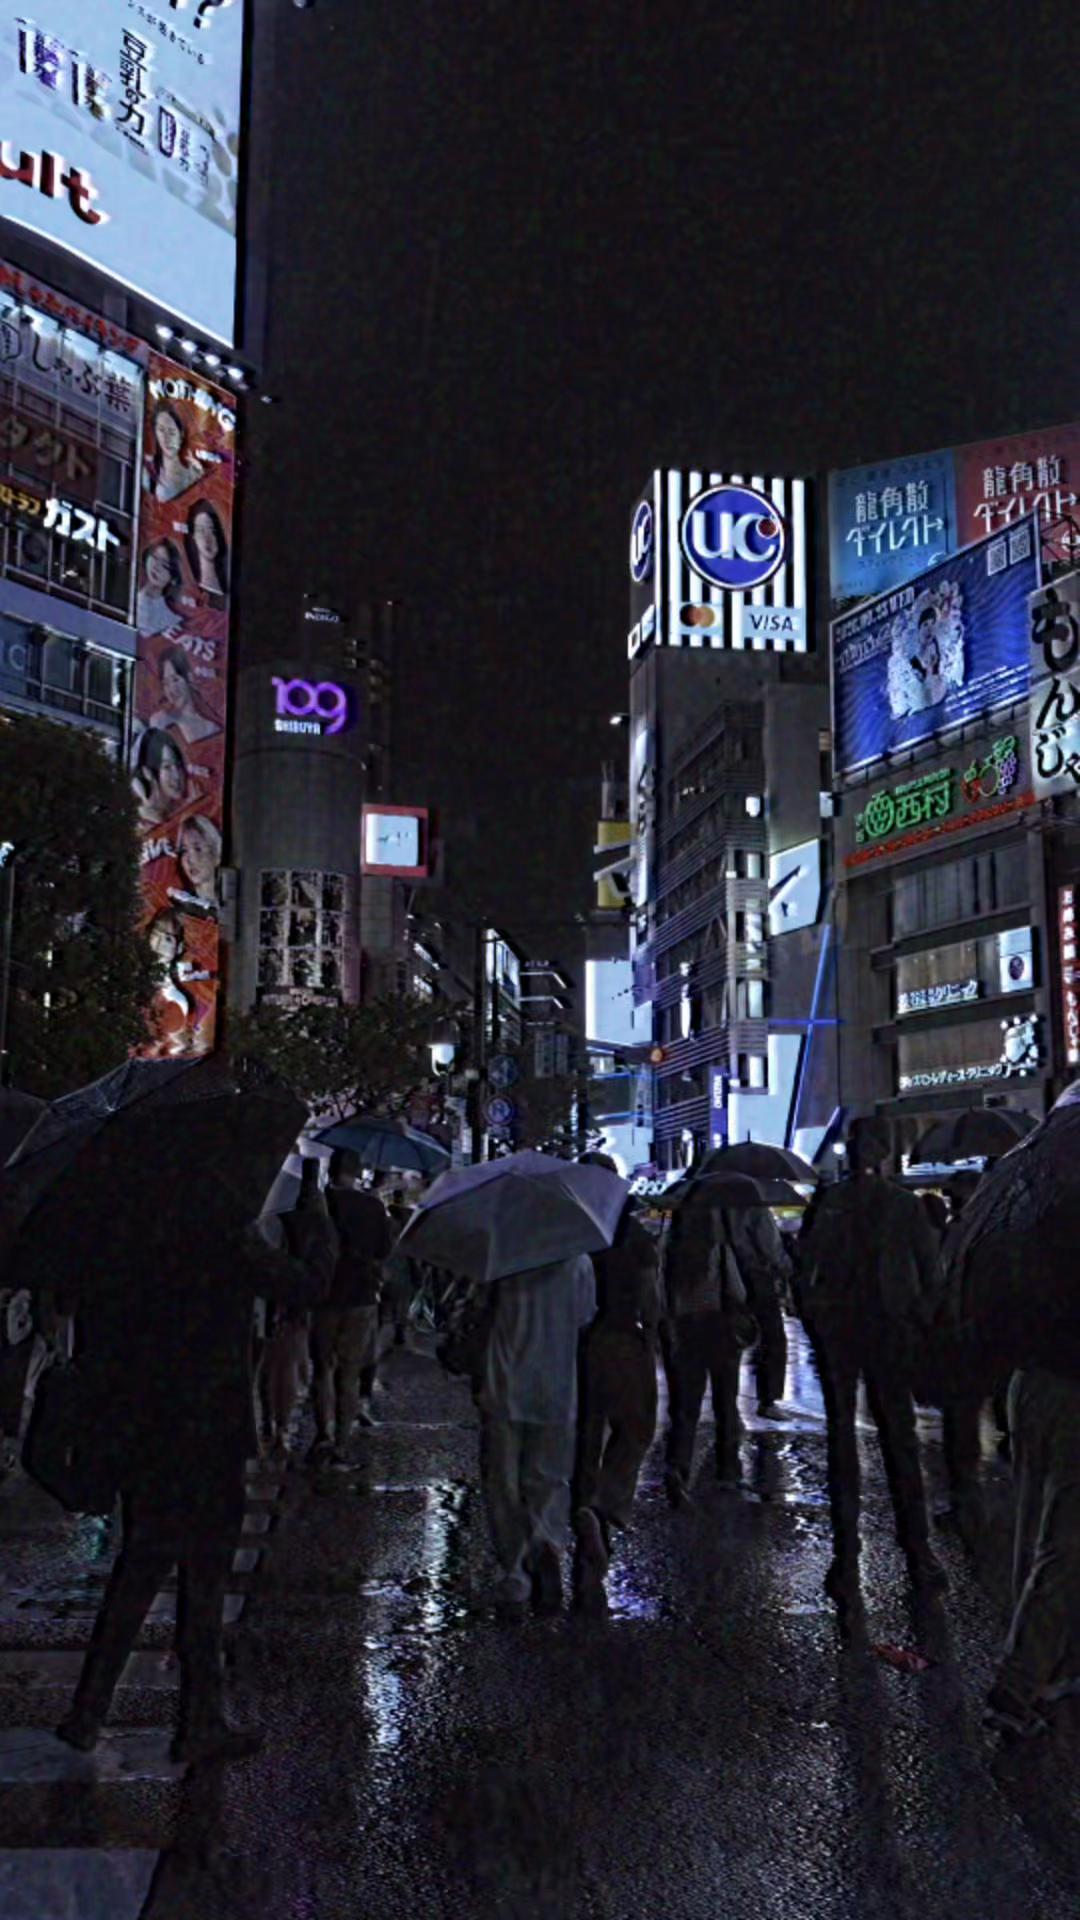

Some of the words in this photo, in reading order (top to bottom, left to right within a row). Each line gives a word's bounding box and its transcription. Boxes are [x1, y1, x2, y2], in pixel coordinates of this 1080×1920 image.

[148, 377, 237, 431] NOTHING
[982, 455, 1062, 499] 龍角散
[855, 480, 929, 523] 龍角散
[43, 498, 120, 552] ガスト
[750, 614, 794, 632] VISA
[271, 676, 347, 736] 109
[274, 718, 321, 735] SHIBUYA
